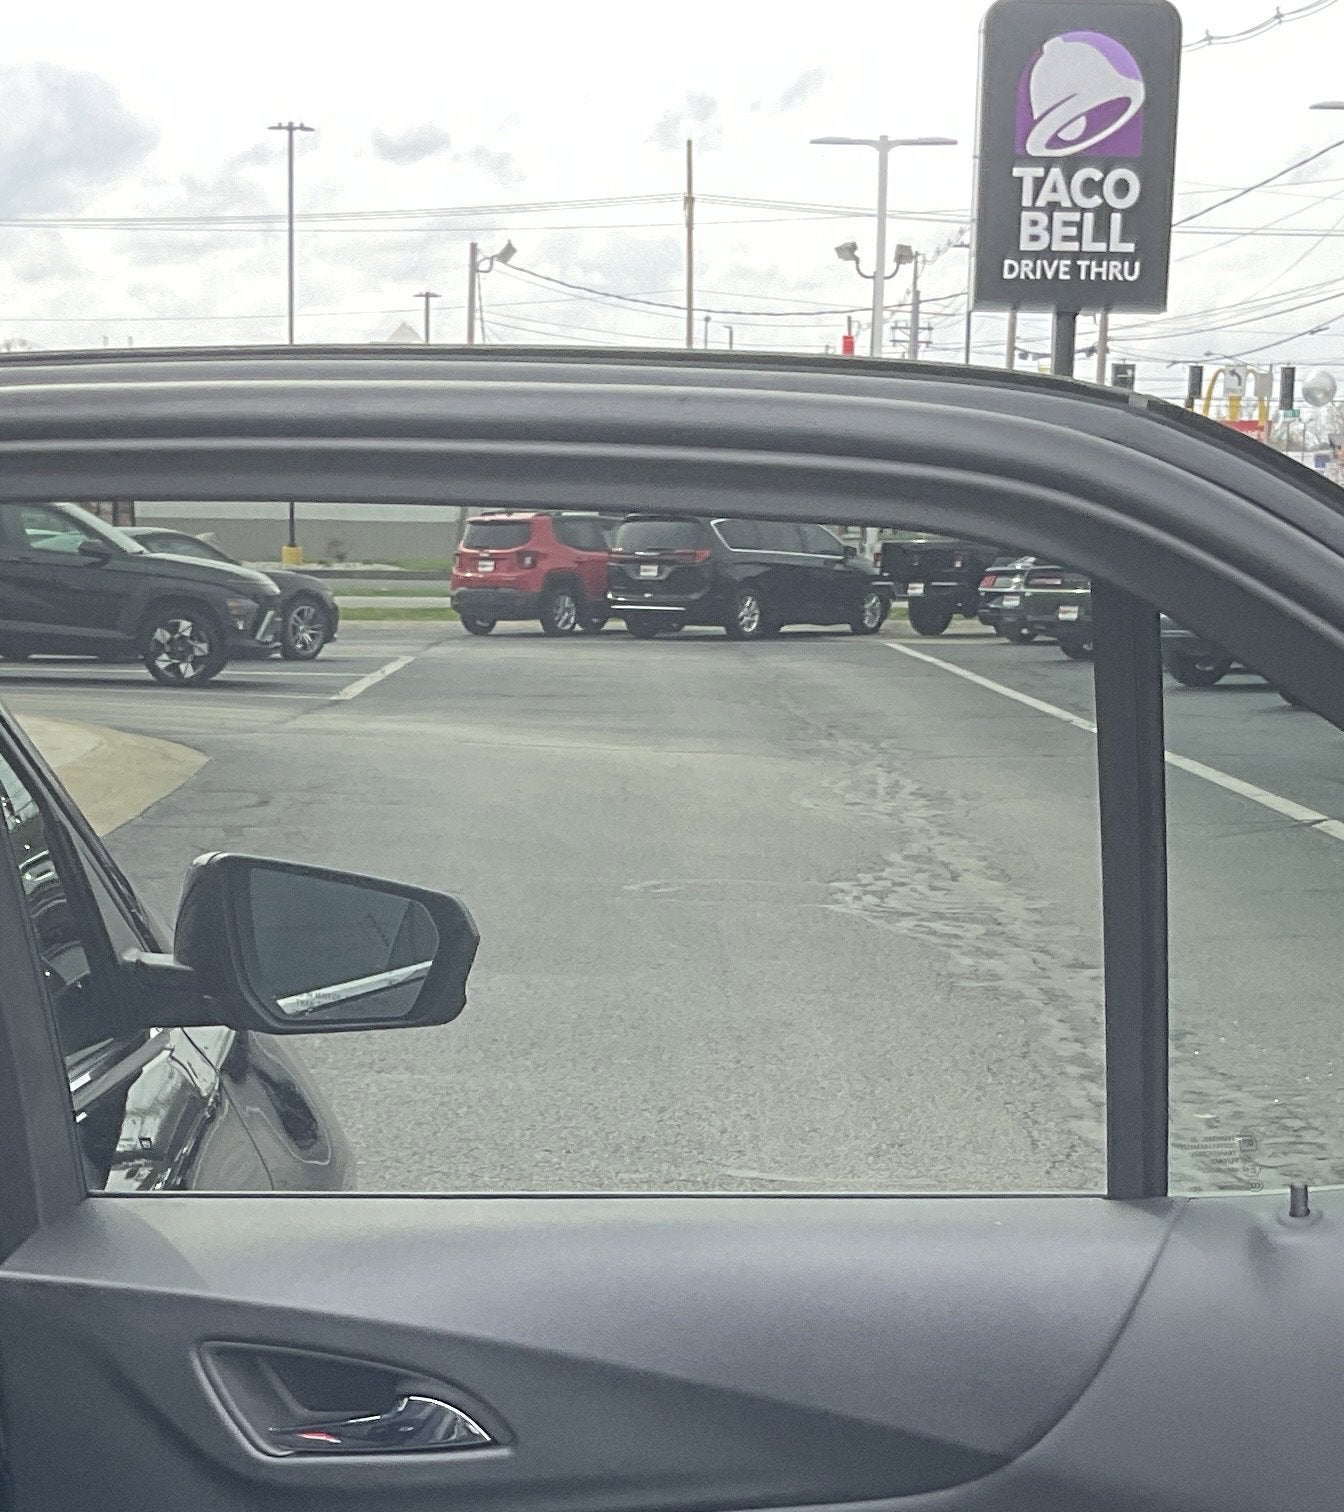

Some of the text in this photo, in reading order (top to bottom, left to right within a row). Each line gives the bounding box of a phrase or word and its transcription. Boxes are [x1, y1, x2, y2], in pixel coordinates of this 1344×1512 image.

[1012, 167, 1141, 209] TACO
[1019, 211, 1135, 252] BELL
[1002, 259, 1141, 281] DRIVE THRU
